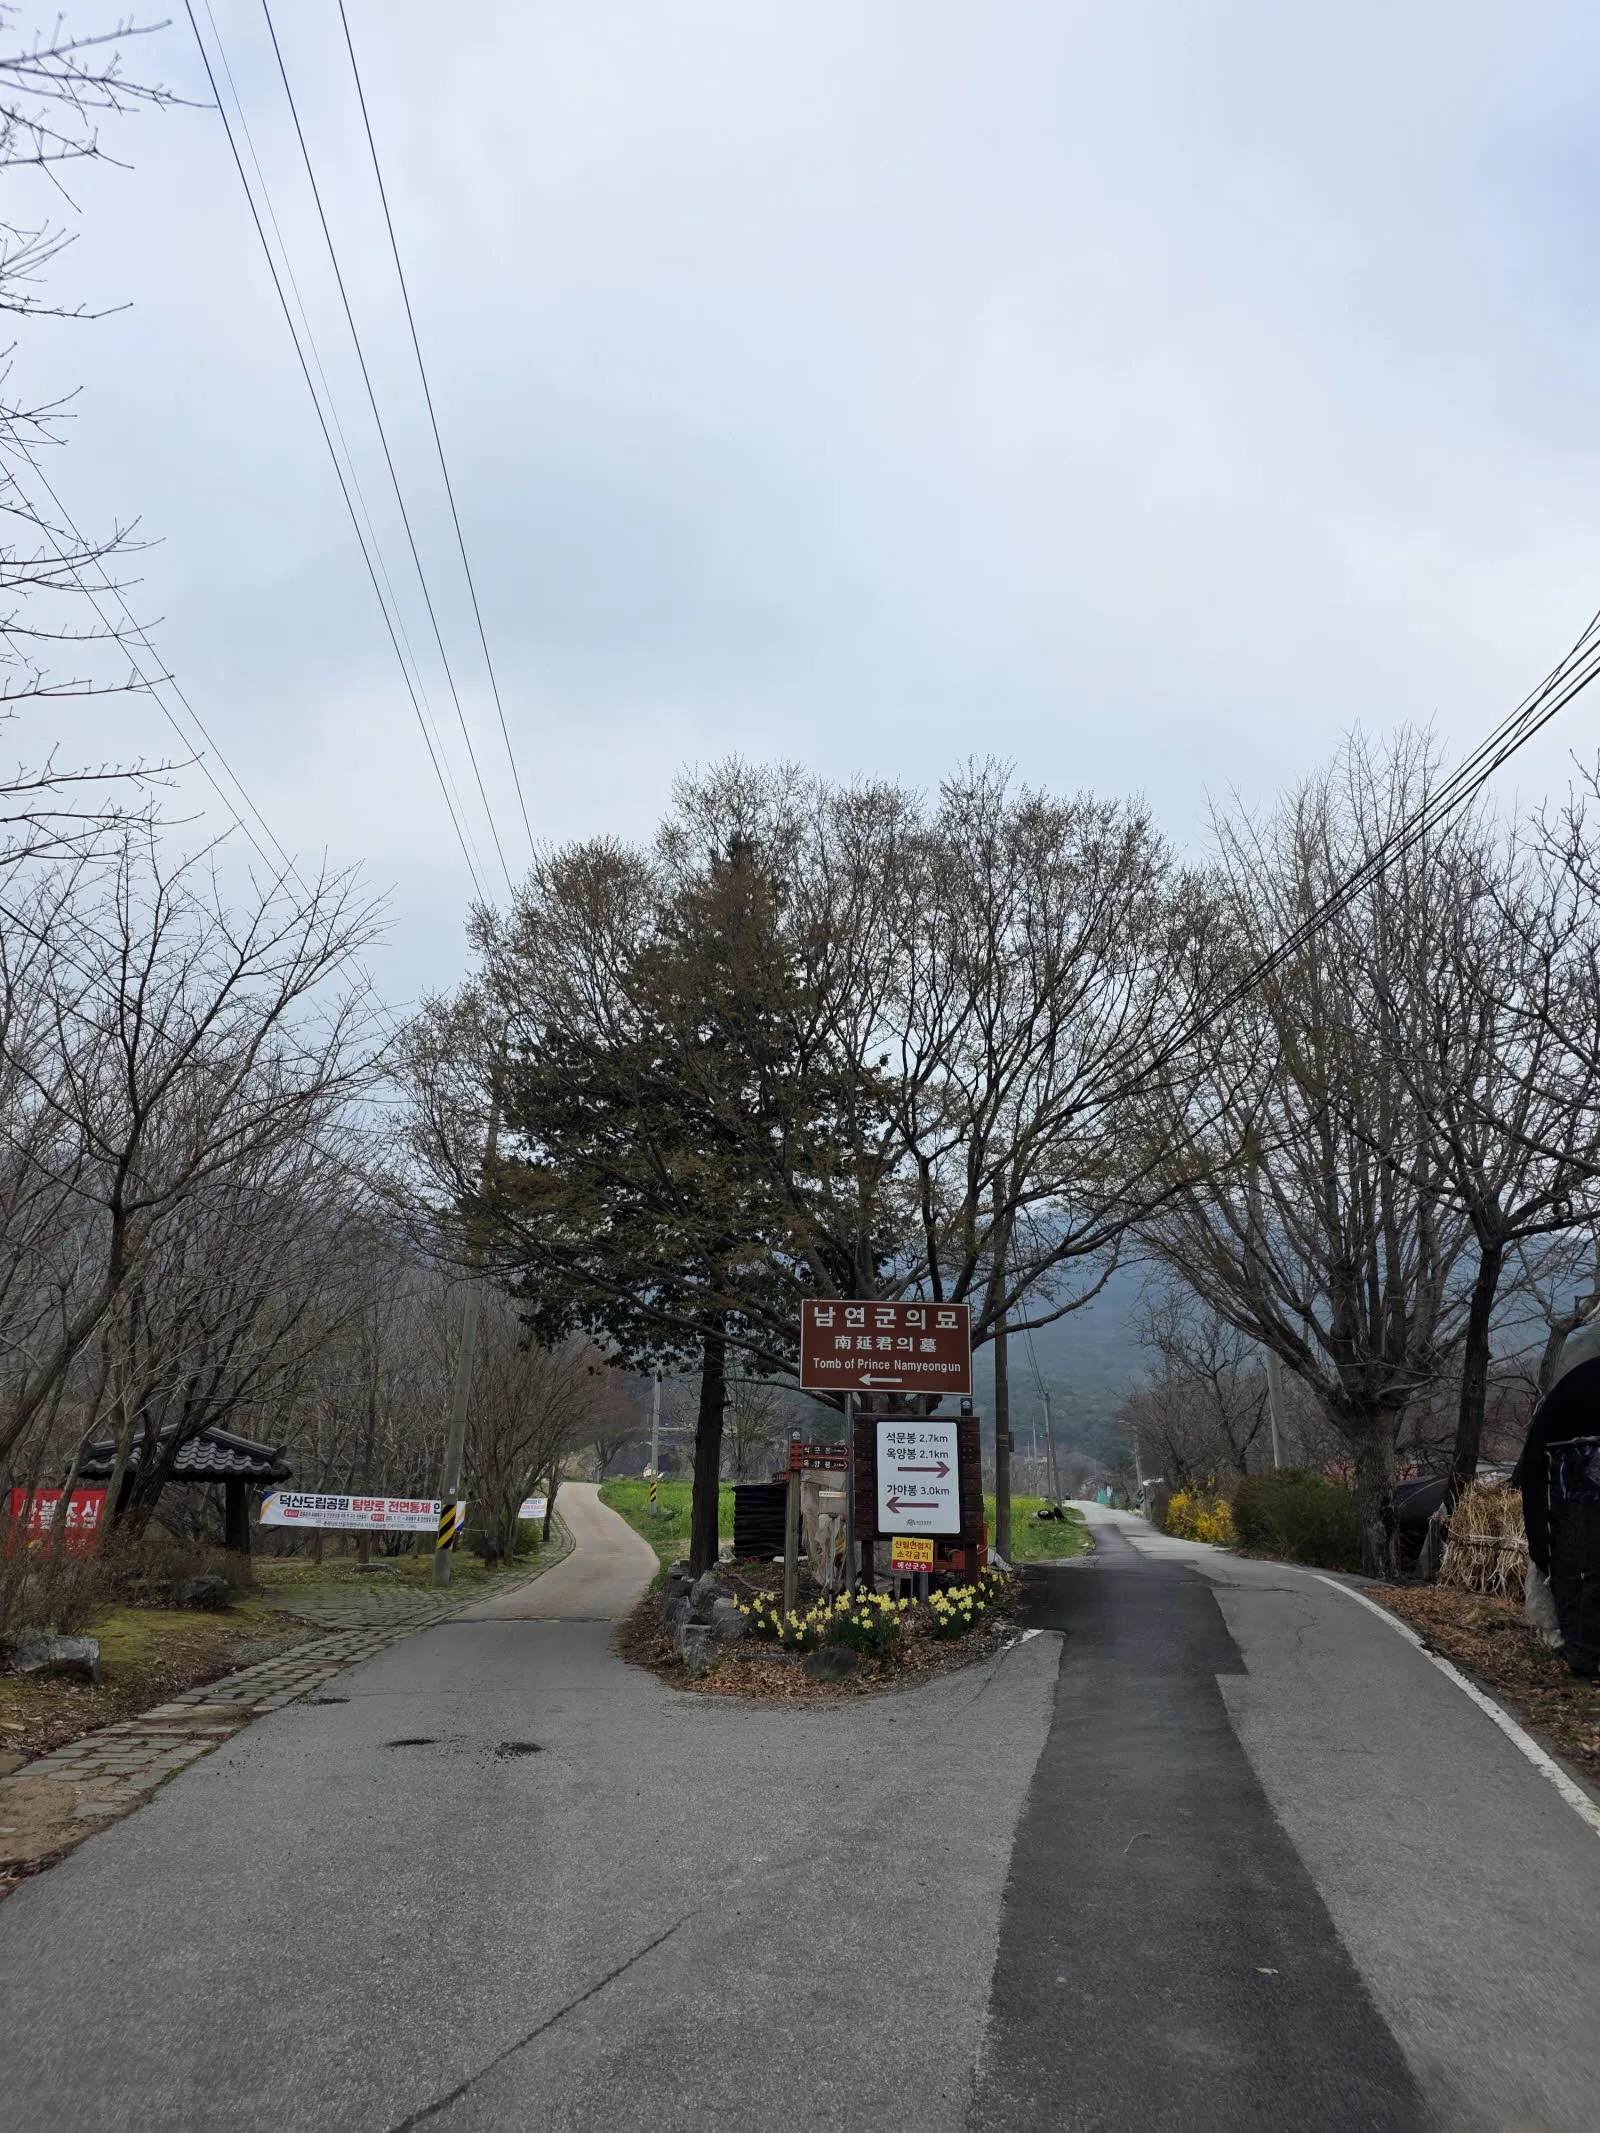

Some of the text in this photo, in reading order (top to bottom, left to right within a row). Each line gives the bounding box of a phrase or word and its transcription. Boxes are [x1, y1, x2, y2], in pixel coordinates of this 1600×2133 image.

[813, 1357, 961, 1372] Tomb of Prince Namyeongun
[886, 1432, 948, 1444] 석문봉 2.7km
[886, 1448, 949, 1460] 옥양봉 2.1km
[886, 1484, 950, 1497] 가야봉 3.0km
[279, 1495, 349, 1511] 덕산도립공원
[352, 1499, 385, 1512] 탐방로
[388, 1500, 431, 1514] 전면통제
[897, 1551, 929, 1560] 소각금지
